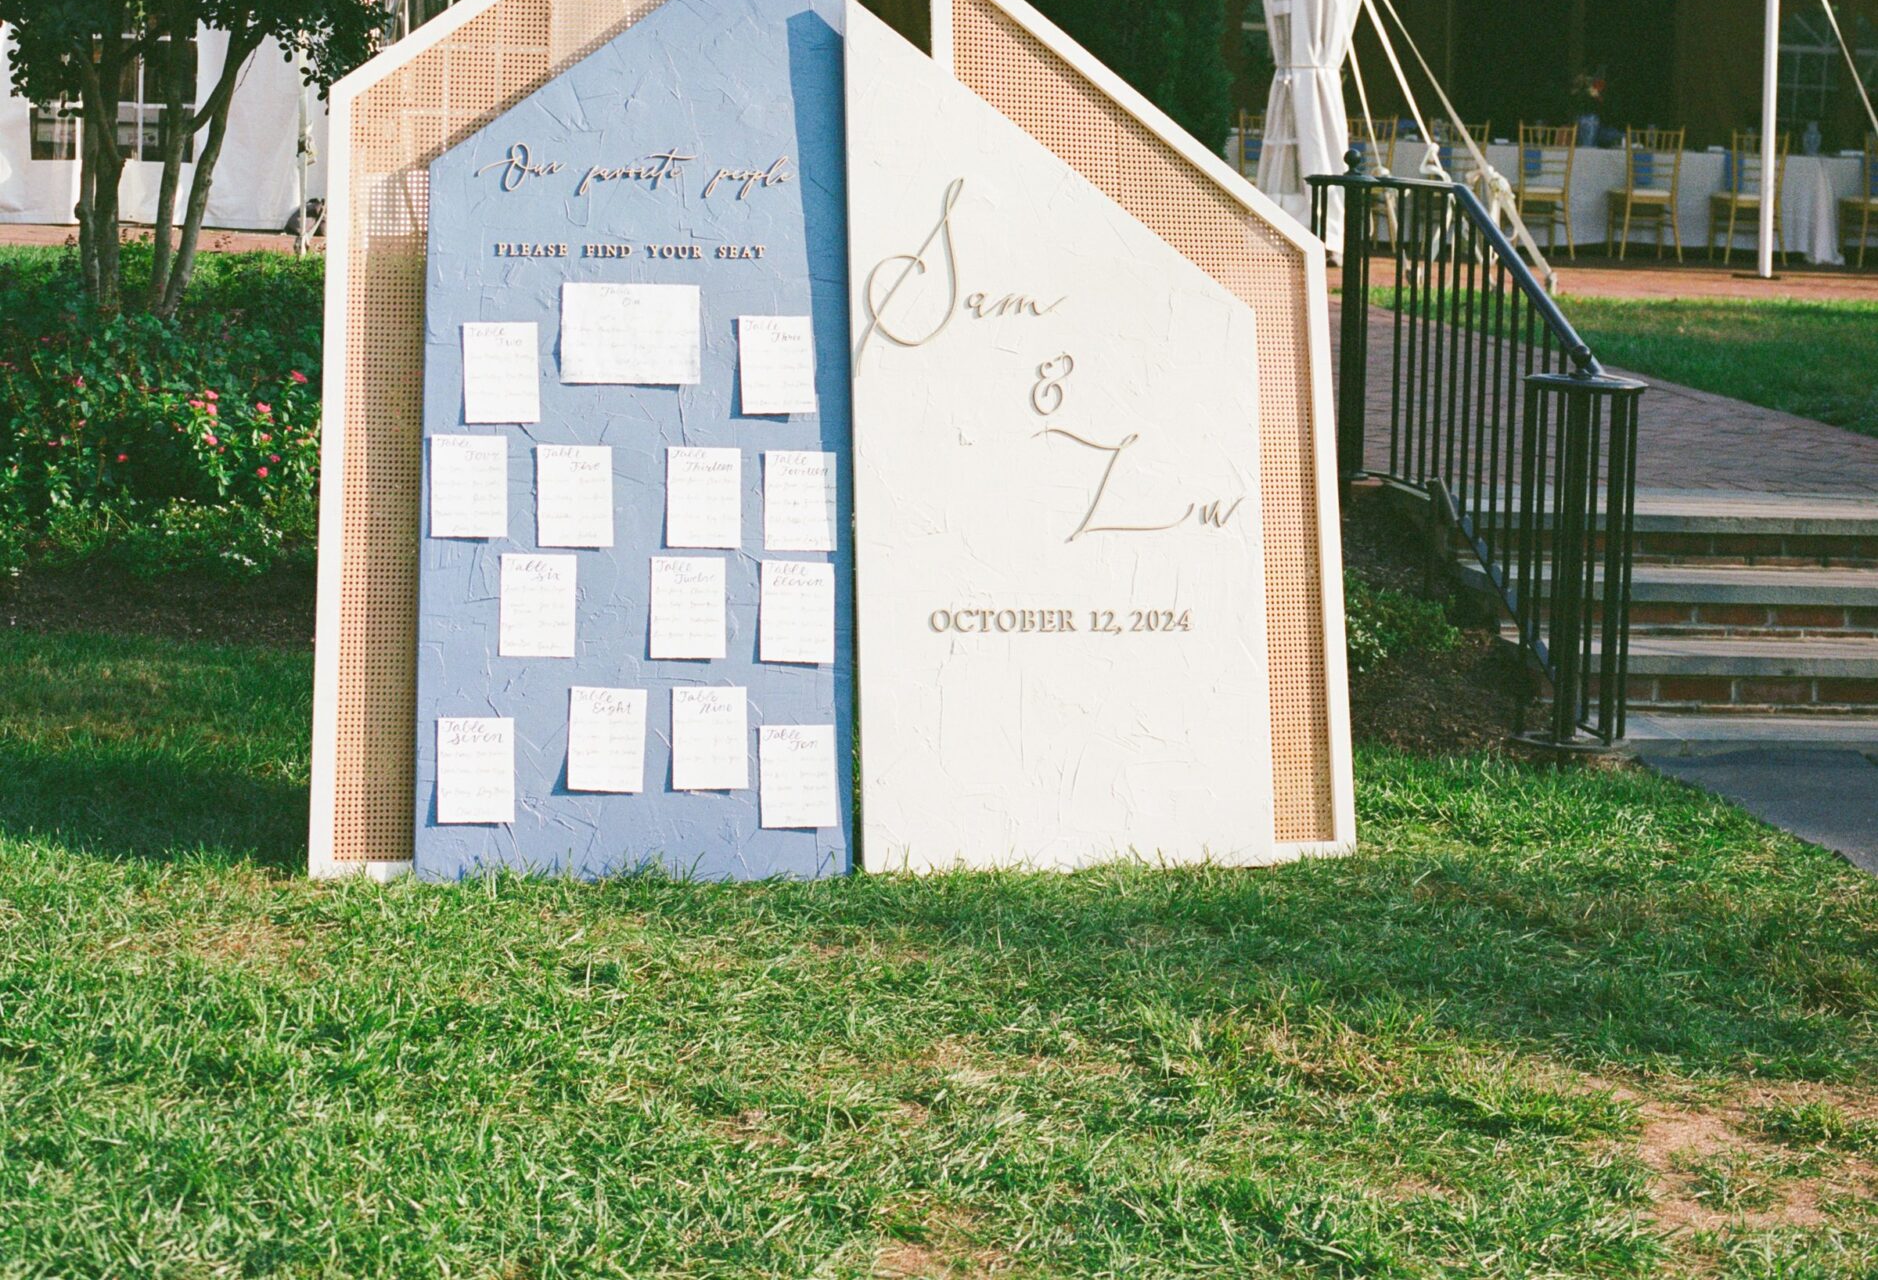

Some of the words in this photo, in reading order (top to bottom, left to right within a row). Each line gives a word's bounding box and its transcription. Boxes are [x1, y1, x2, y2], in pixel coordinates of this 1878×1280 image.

[474, 142, 567, 191] Our
[577, 147, 697, 196] favorite
[702, 155, 796, 200] people
[496, 242, 569, 258] PLEASE
[586, 243, 632, 258] FIND
[646, 243, 703, 258] YOUR
[717, 243, 767, 260] SEAT
[854, 177, 1069, 378] Sam
[1030, 351, 1074, 416] &
[506, 558, 546, 573] Table
[767, 563, 807, 576] Table
[928, 608, 1077, 633] OCTOBER
[1129, 609, 1195, 633] 2024
[575, 689, 613, 703] Table
[676, 690, 720, 704] Table
[593, 701, 632, 716] Eight
[445, 720, 486, 734] Table
[763, 728, 802, 742] Table
[788, 739, 818, 752] Ten
